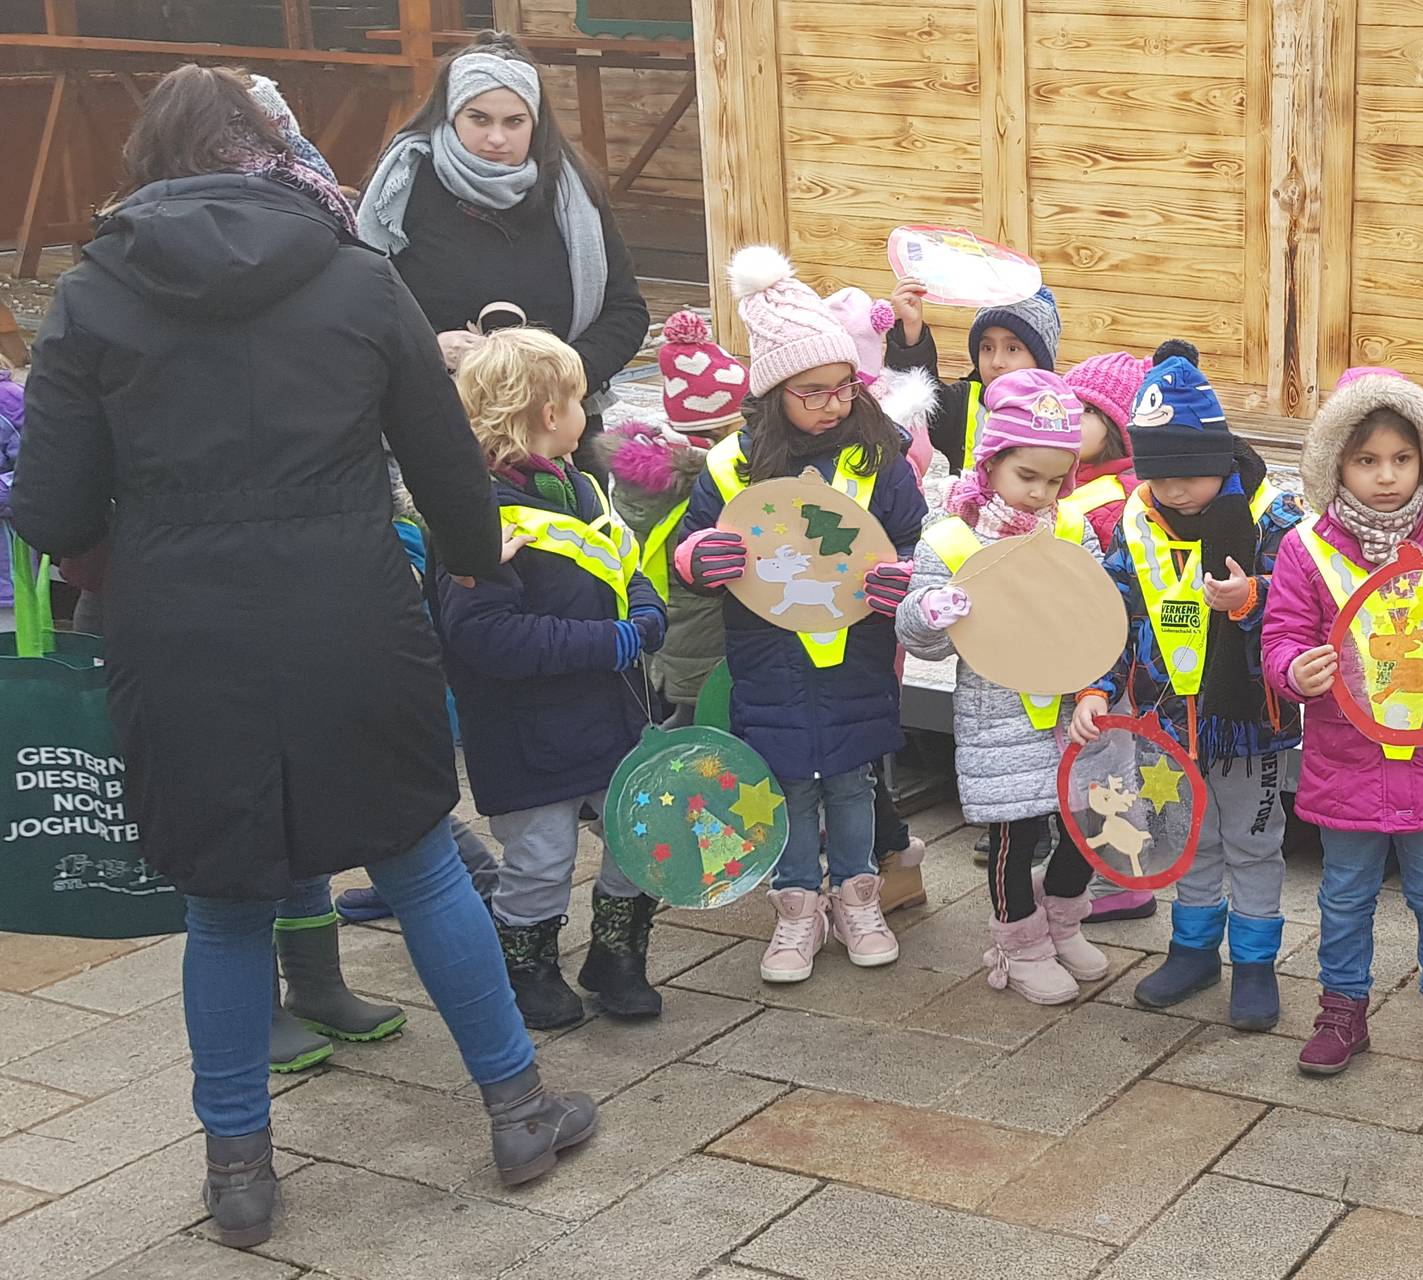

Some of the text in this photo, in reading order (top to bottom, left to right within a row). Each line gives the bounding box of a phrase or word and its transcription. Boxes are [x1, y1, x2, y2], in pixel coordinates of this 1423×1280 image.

[1161, 613, 1190, 623] WACHT
[17, 747, 126, 776] GESTERN
[16, 770, 124, 798] DIESER B
[53, 793, 125, 821] NOCH
